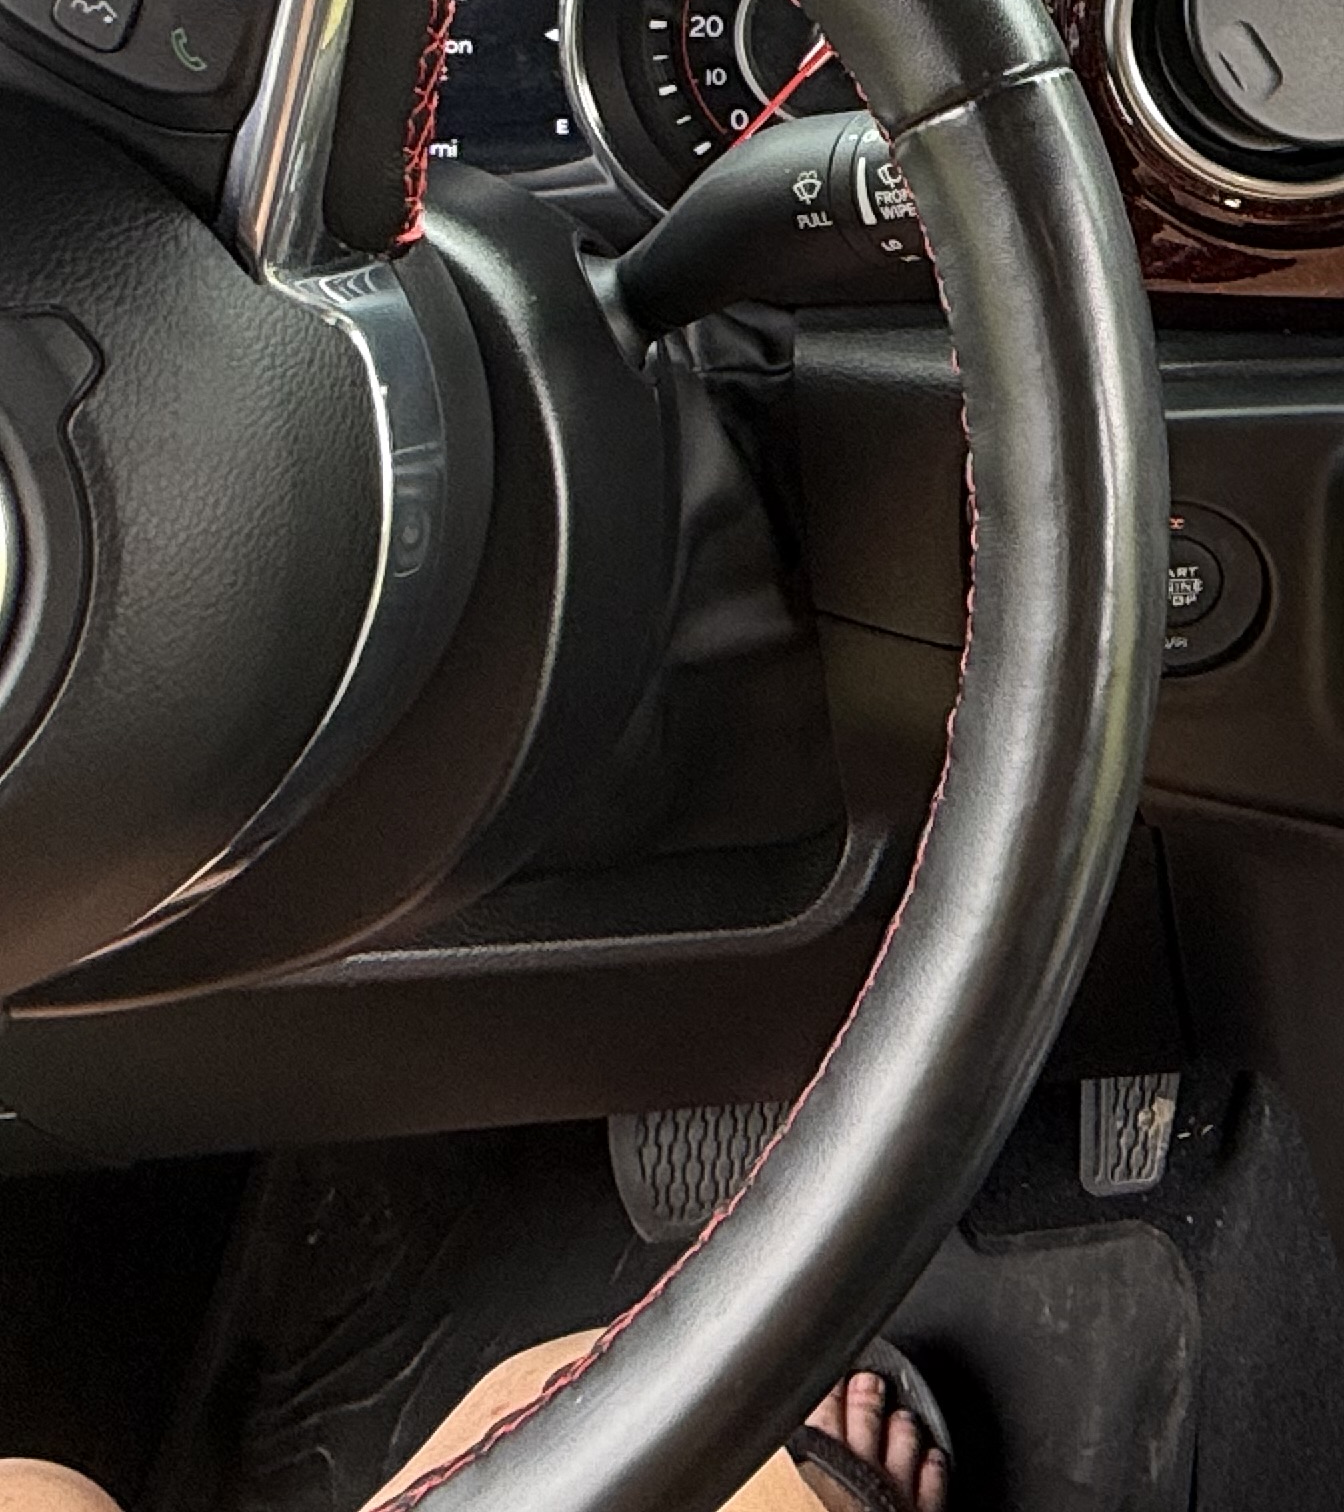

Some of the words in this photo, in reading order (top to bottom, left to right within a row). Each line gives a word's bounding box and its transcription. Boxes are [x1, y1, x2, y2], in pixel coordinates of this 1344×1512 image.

[690, 16, 724, 39] 20
[705, 68, 727, 86] 10
[556, 118, 570, 135] E
[731, 110, 749, 131] 0
[797, 212, 833, 229] PULL
